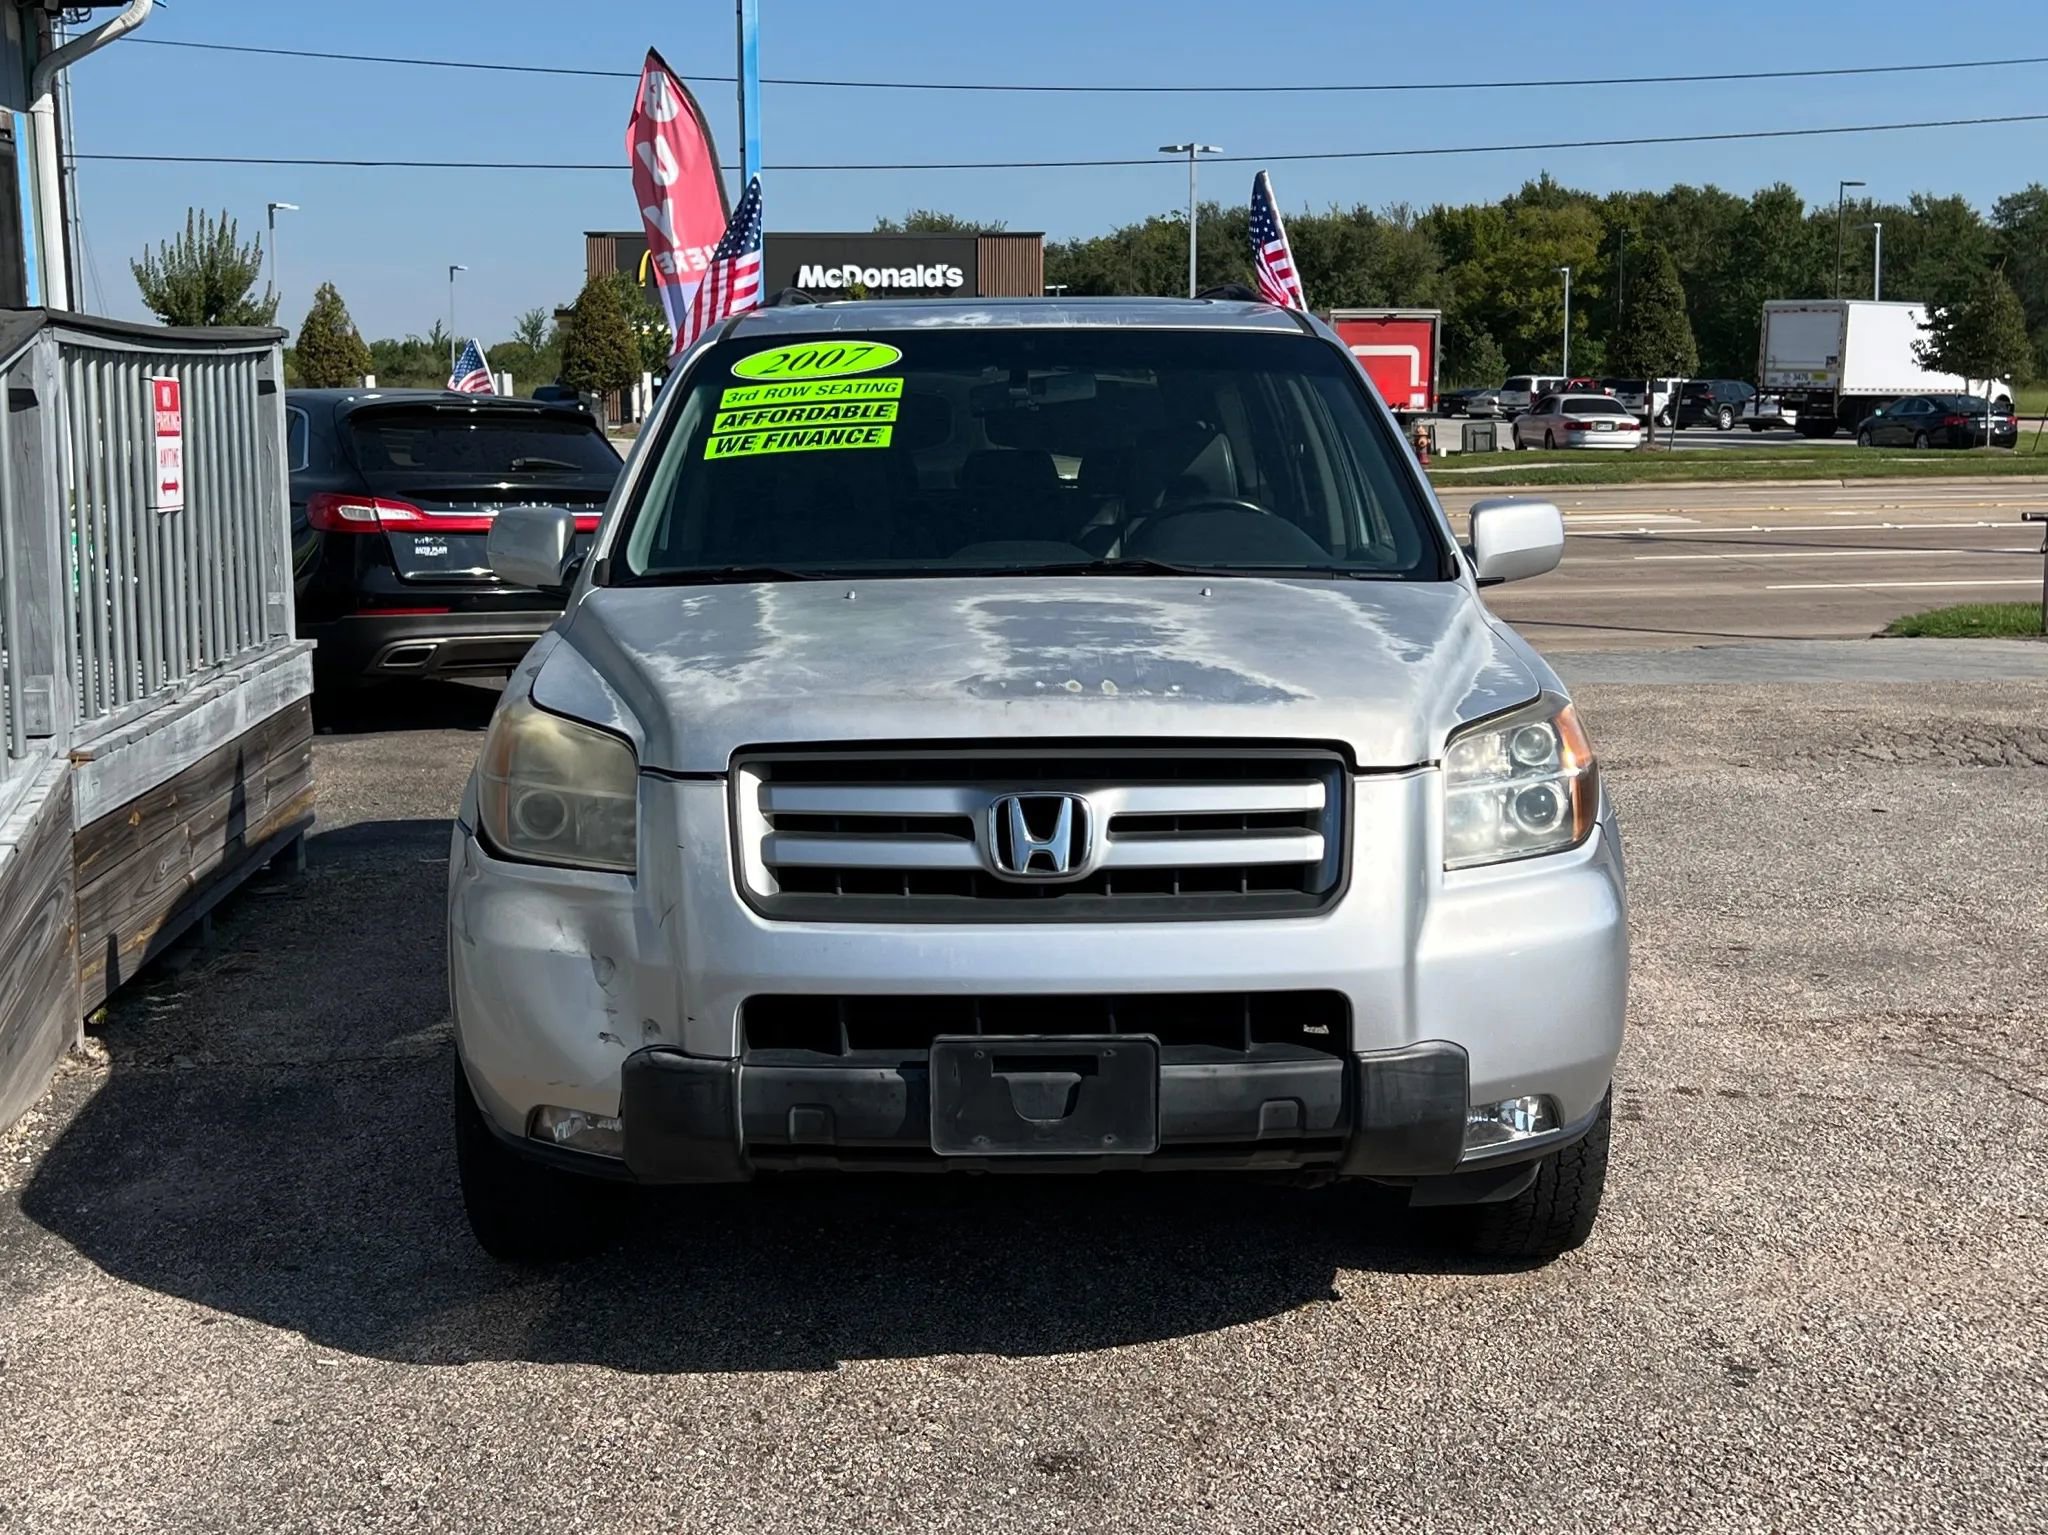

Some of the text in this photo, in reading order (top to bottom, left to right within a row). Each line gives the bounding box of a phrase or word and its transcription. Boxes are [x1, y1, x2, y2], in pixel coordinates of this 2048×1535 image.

[797, 264, 964, 289] McDonald's
[758, 346, 876, 375] 2007
[725, 382, 899, 404] 3rd ROW SEATING
[717, 404, 896, 429] AFFORDABLE
[714, 428, 885, 455] WE FINANCE
